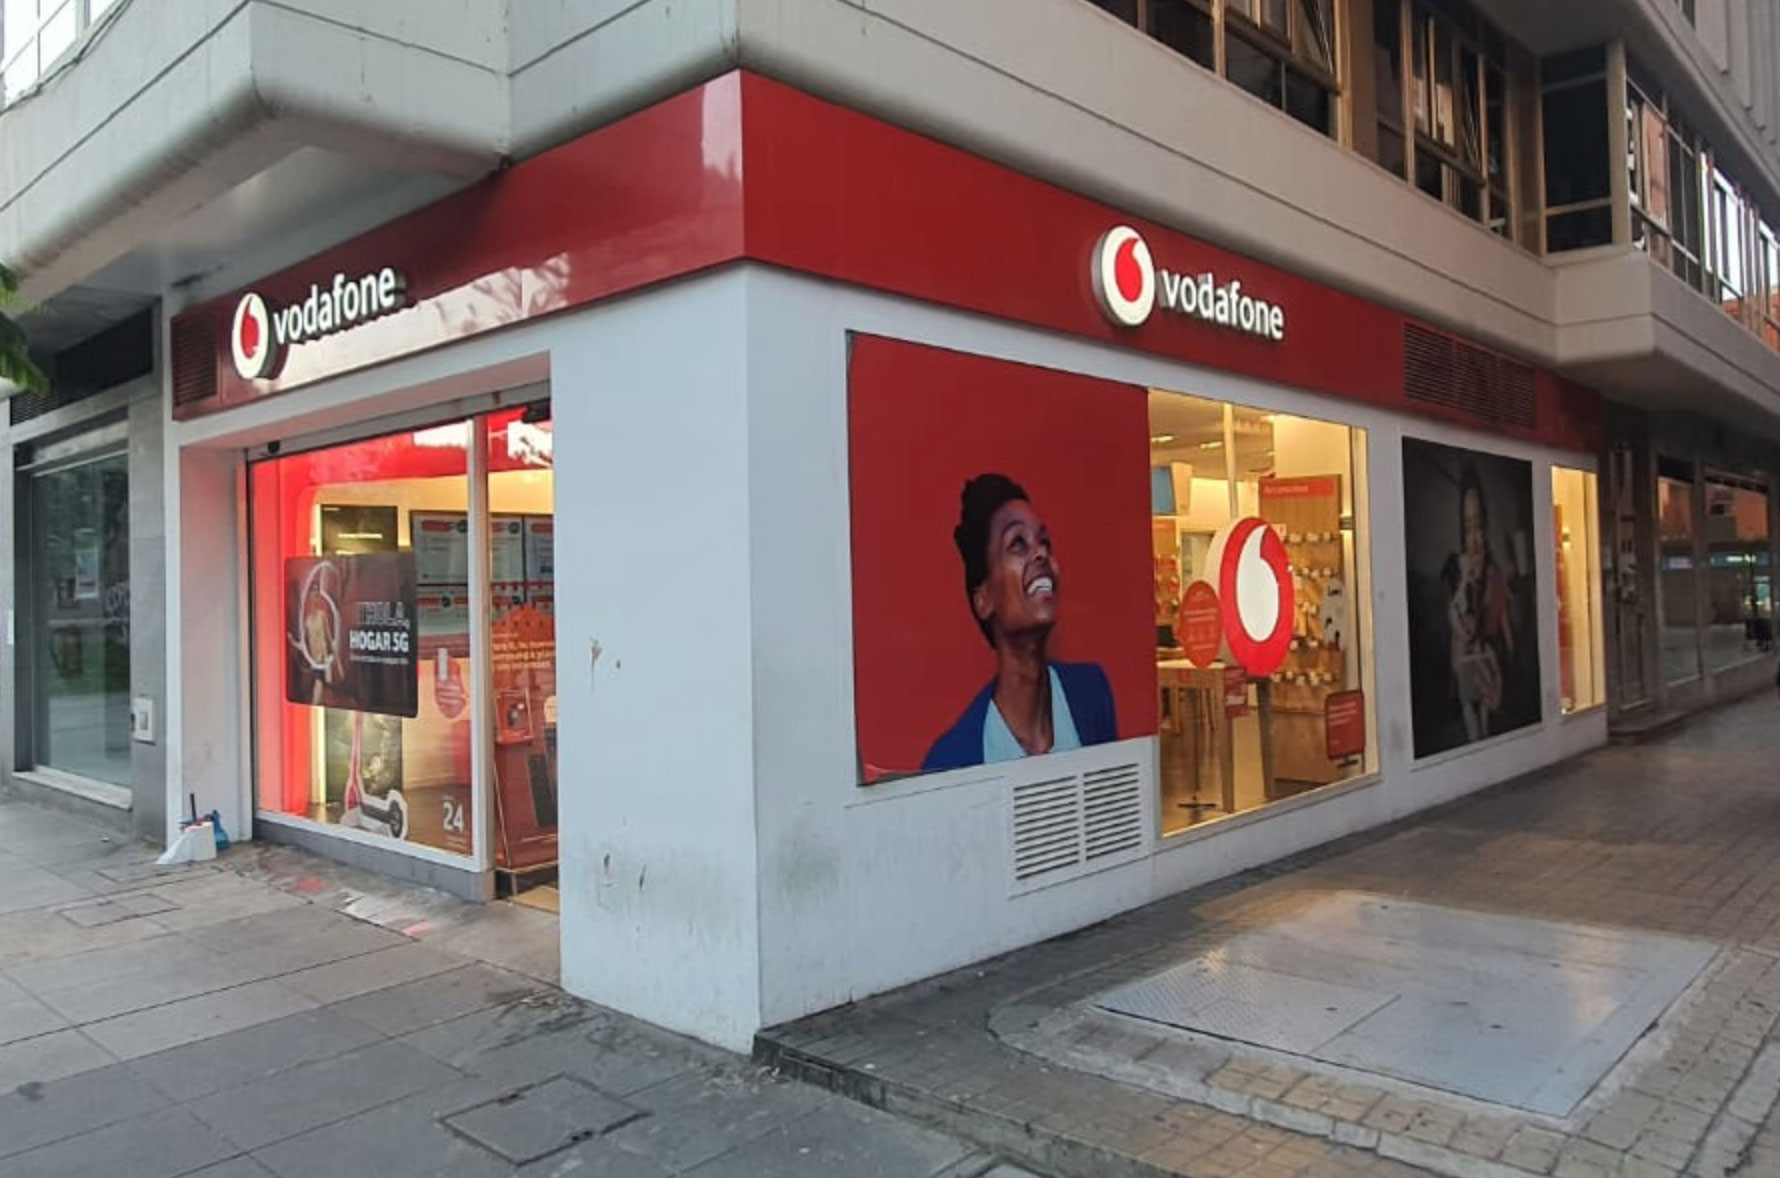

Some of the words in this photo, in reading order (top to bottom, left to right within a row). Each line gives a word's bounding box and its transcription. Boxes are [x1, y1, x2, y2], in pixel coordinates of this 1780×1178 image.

[273, 267, 396, 344] vodafone
[1161, 269, 1284, 340] vodafone
[349, 629, 391, 652] HOGAR
[392, 631, 409, 653] 5G
[443, 801, 464, 833] 24
